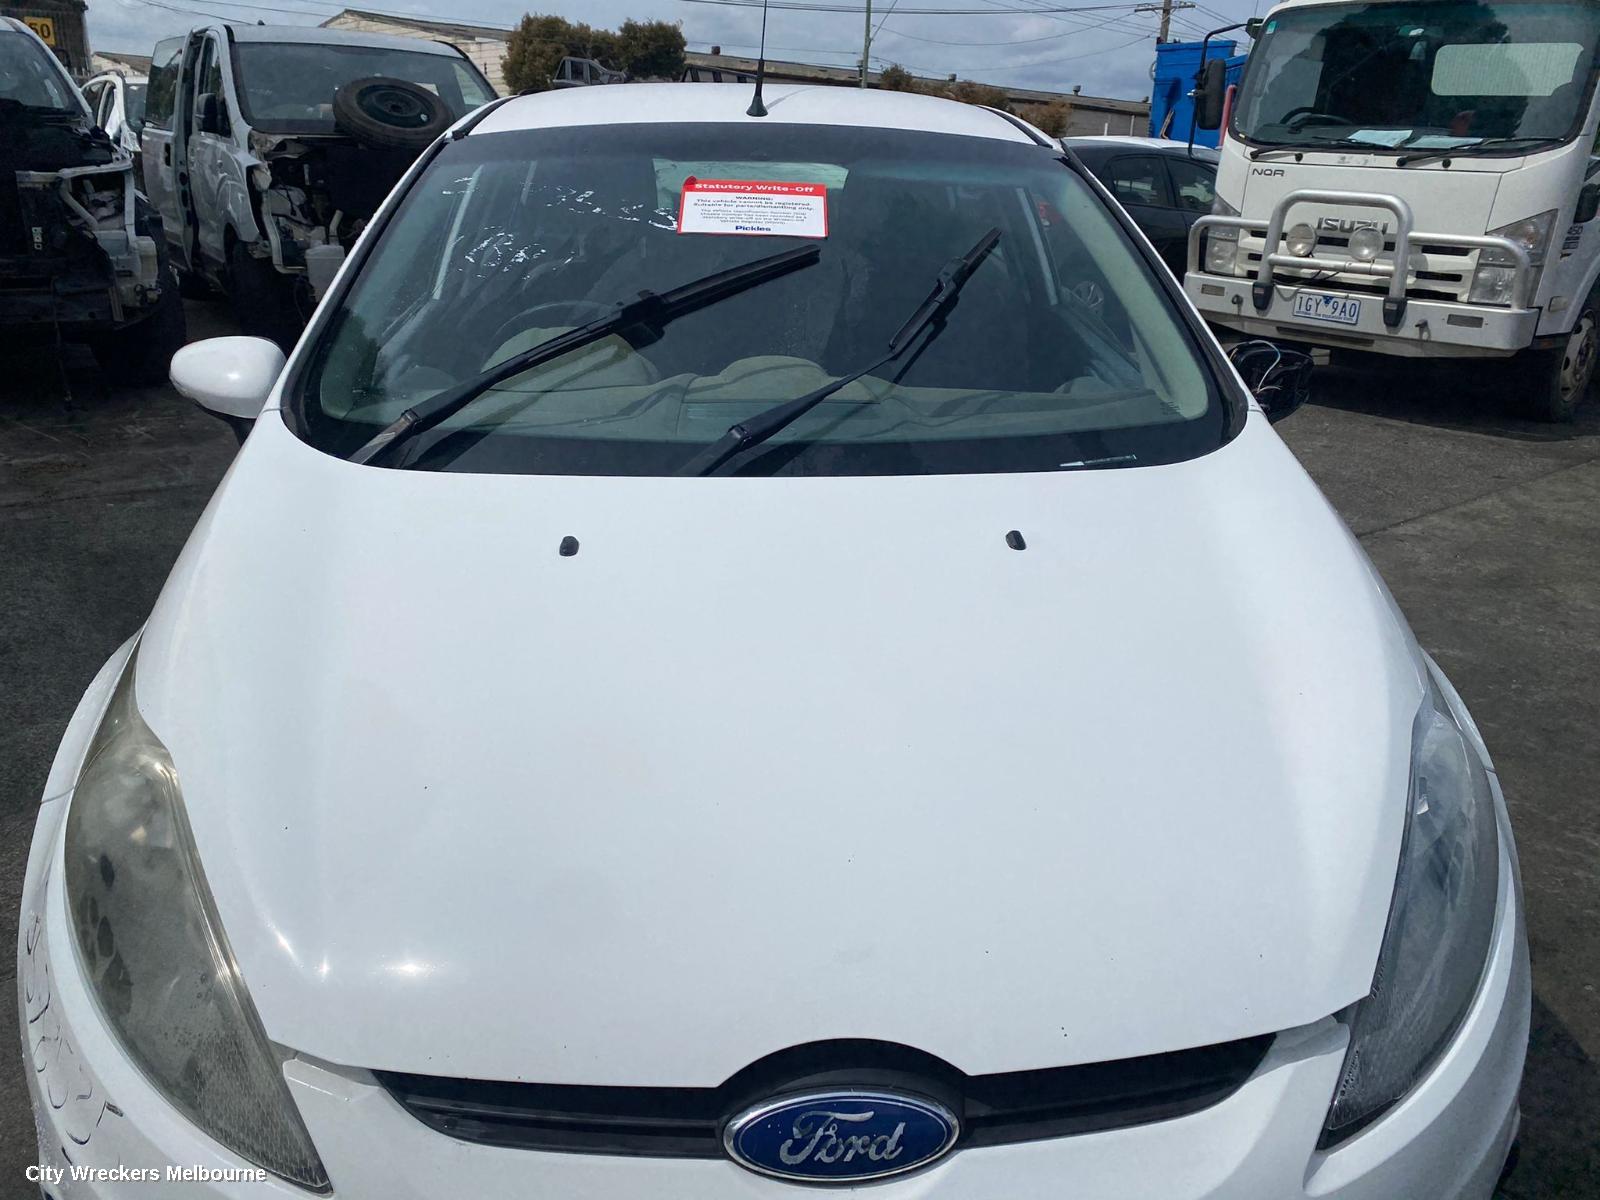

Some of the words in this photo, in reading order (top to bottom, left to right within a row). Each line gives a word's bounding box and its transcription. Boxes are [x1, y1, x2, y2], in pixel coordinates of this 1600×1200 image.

[1252, 168, 1285, 177] NQR
[695, 183, 753, 191] Statutory
[779, 1110, 906, 1165] Ford
